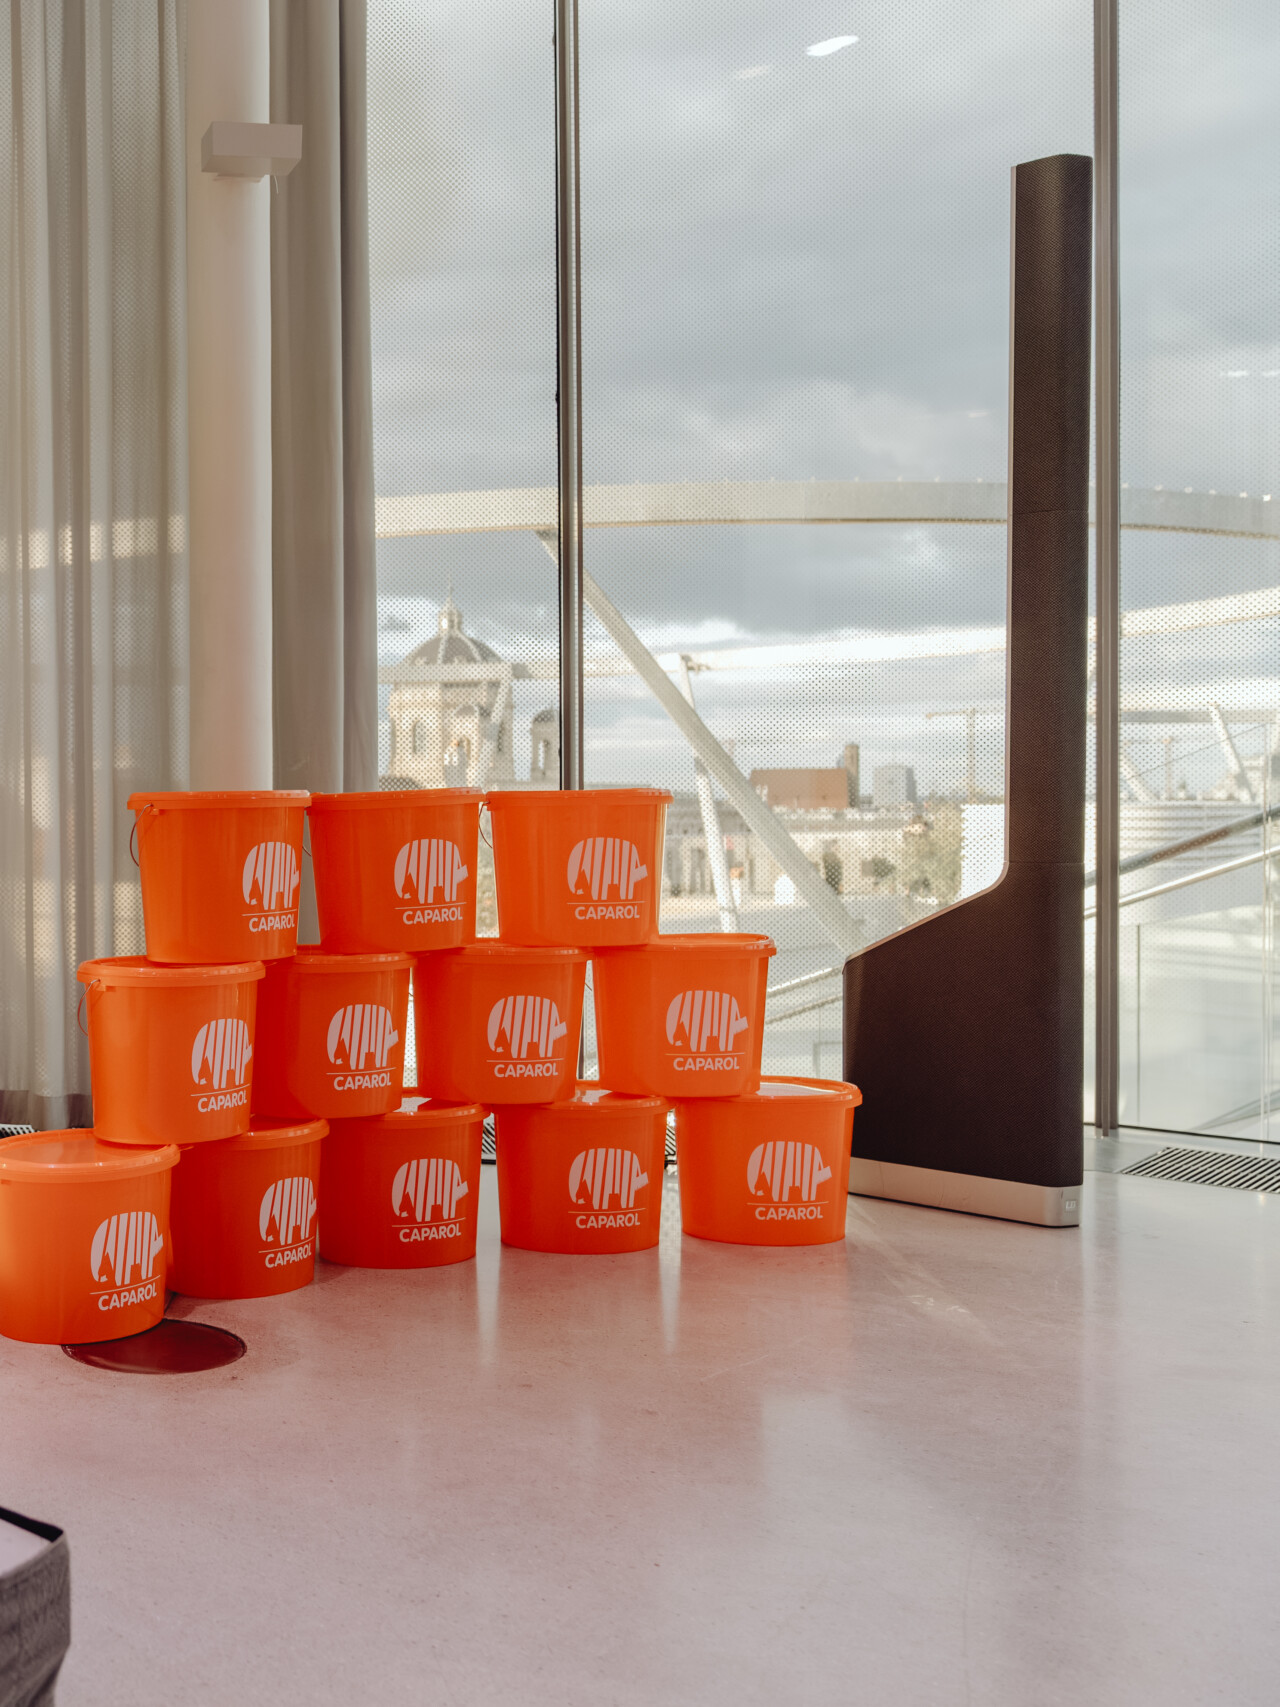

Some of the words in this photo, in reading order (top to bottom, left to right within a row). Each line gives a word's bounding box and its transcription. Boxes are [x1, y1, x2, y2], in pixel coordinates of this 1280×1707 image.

[403, 906, 463, 925] CAPAROL
[575, 905, 640, 920] CAPAROL
[249, 912, 295, 932] CAPAROL
[494, 1062, 558, 1078] CAPAROL
[673, 1056, 739, 1071] CAPAROL
[334, 1074, 391, 1091] CAPAROL
[198, 1091, 247, 1113] CAPAROL
[576, 1212, 640, 1229] CAPAROL
[755, 1206, 823, 1221] CAPAROL
[399, 1223, 461, 1242] CAPAROL
[265, 1243, 311, 1268] CAPAROL
[98, 1283, 157, 1311] CAPAROL
